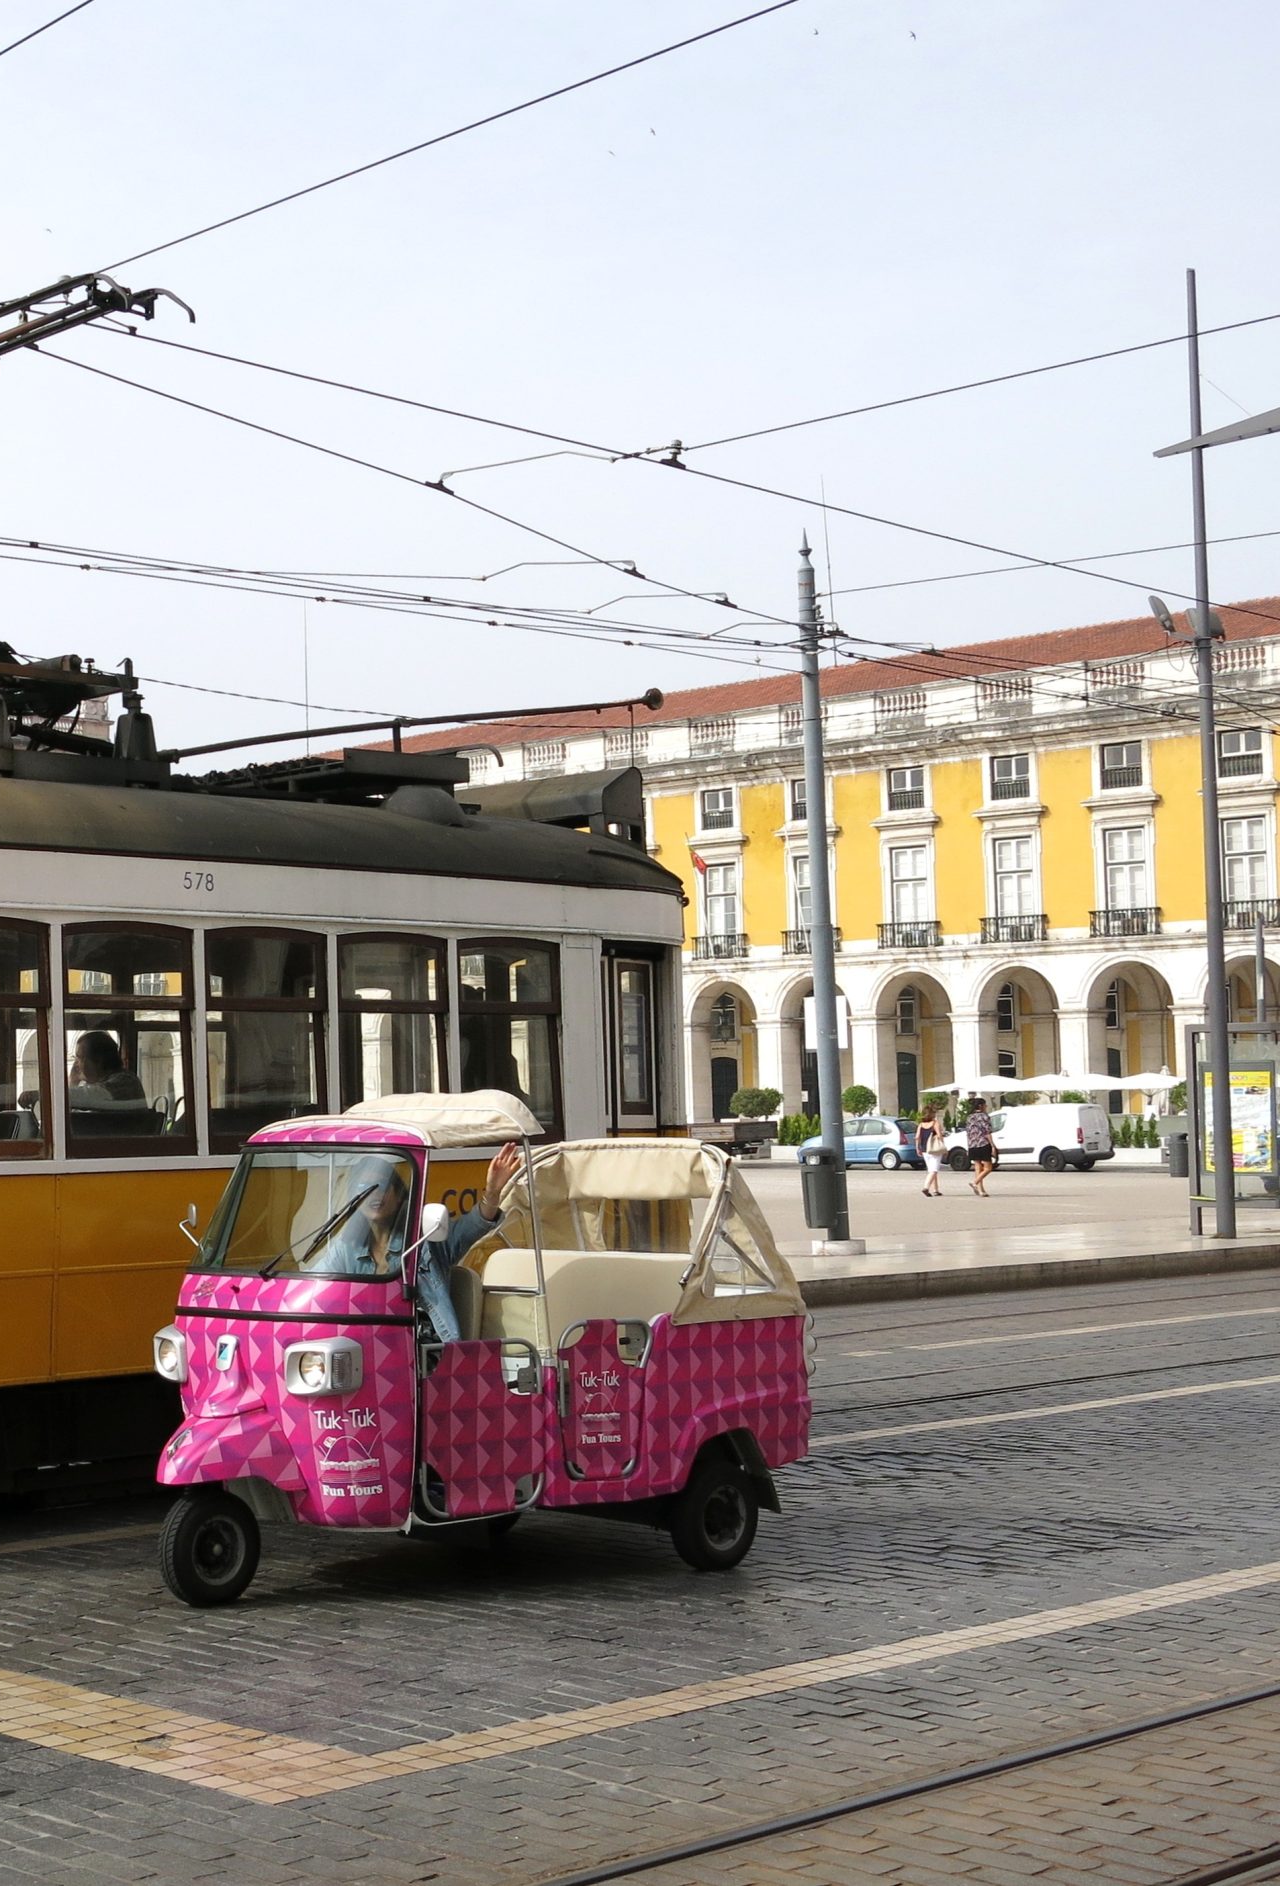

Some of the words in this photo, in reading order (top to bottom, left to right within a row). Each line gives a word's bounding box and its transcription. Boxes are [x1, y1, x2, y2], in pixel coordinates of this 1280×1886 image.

[183, 871, 215, 892] 578
[580, 1369, 621, 1388] Tuk-Tuk
[313, 1406, 377, 1431] Tuk-Tuk
[581, 1434, 597, 1445] Fun
[598, 1433, 622, 1444] Tours
[322, 1484, 346, 1498] Fun
[347, 1484, 383, 1498] Tours
